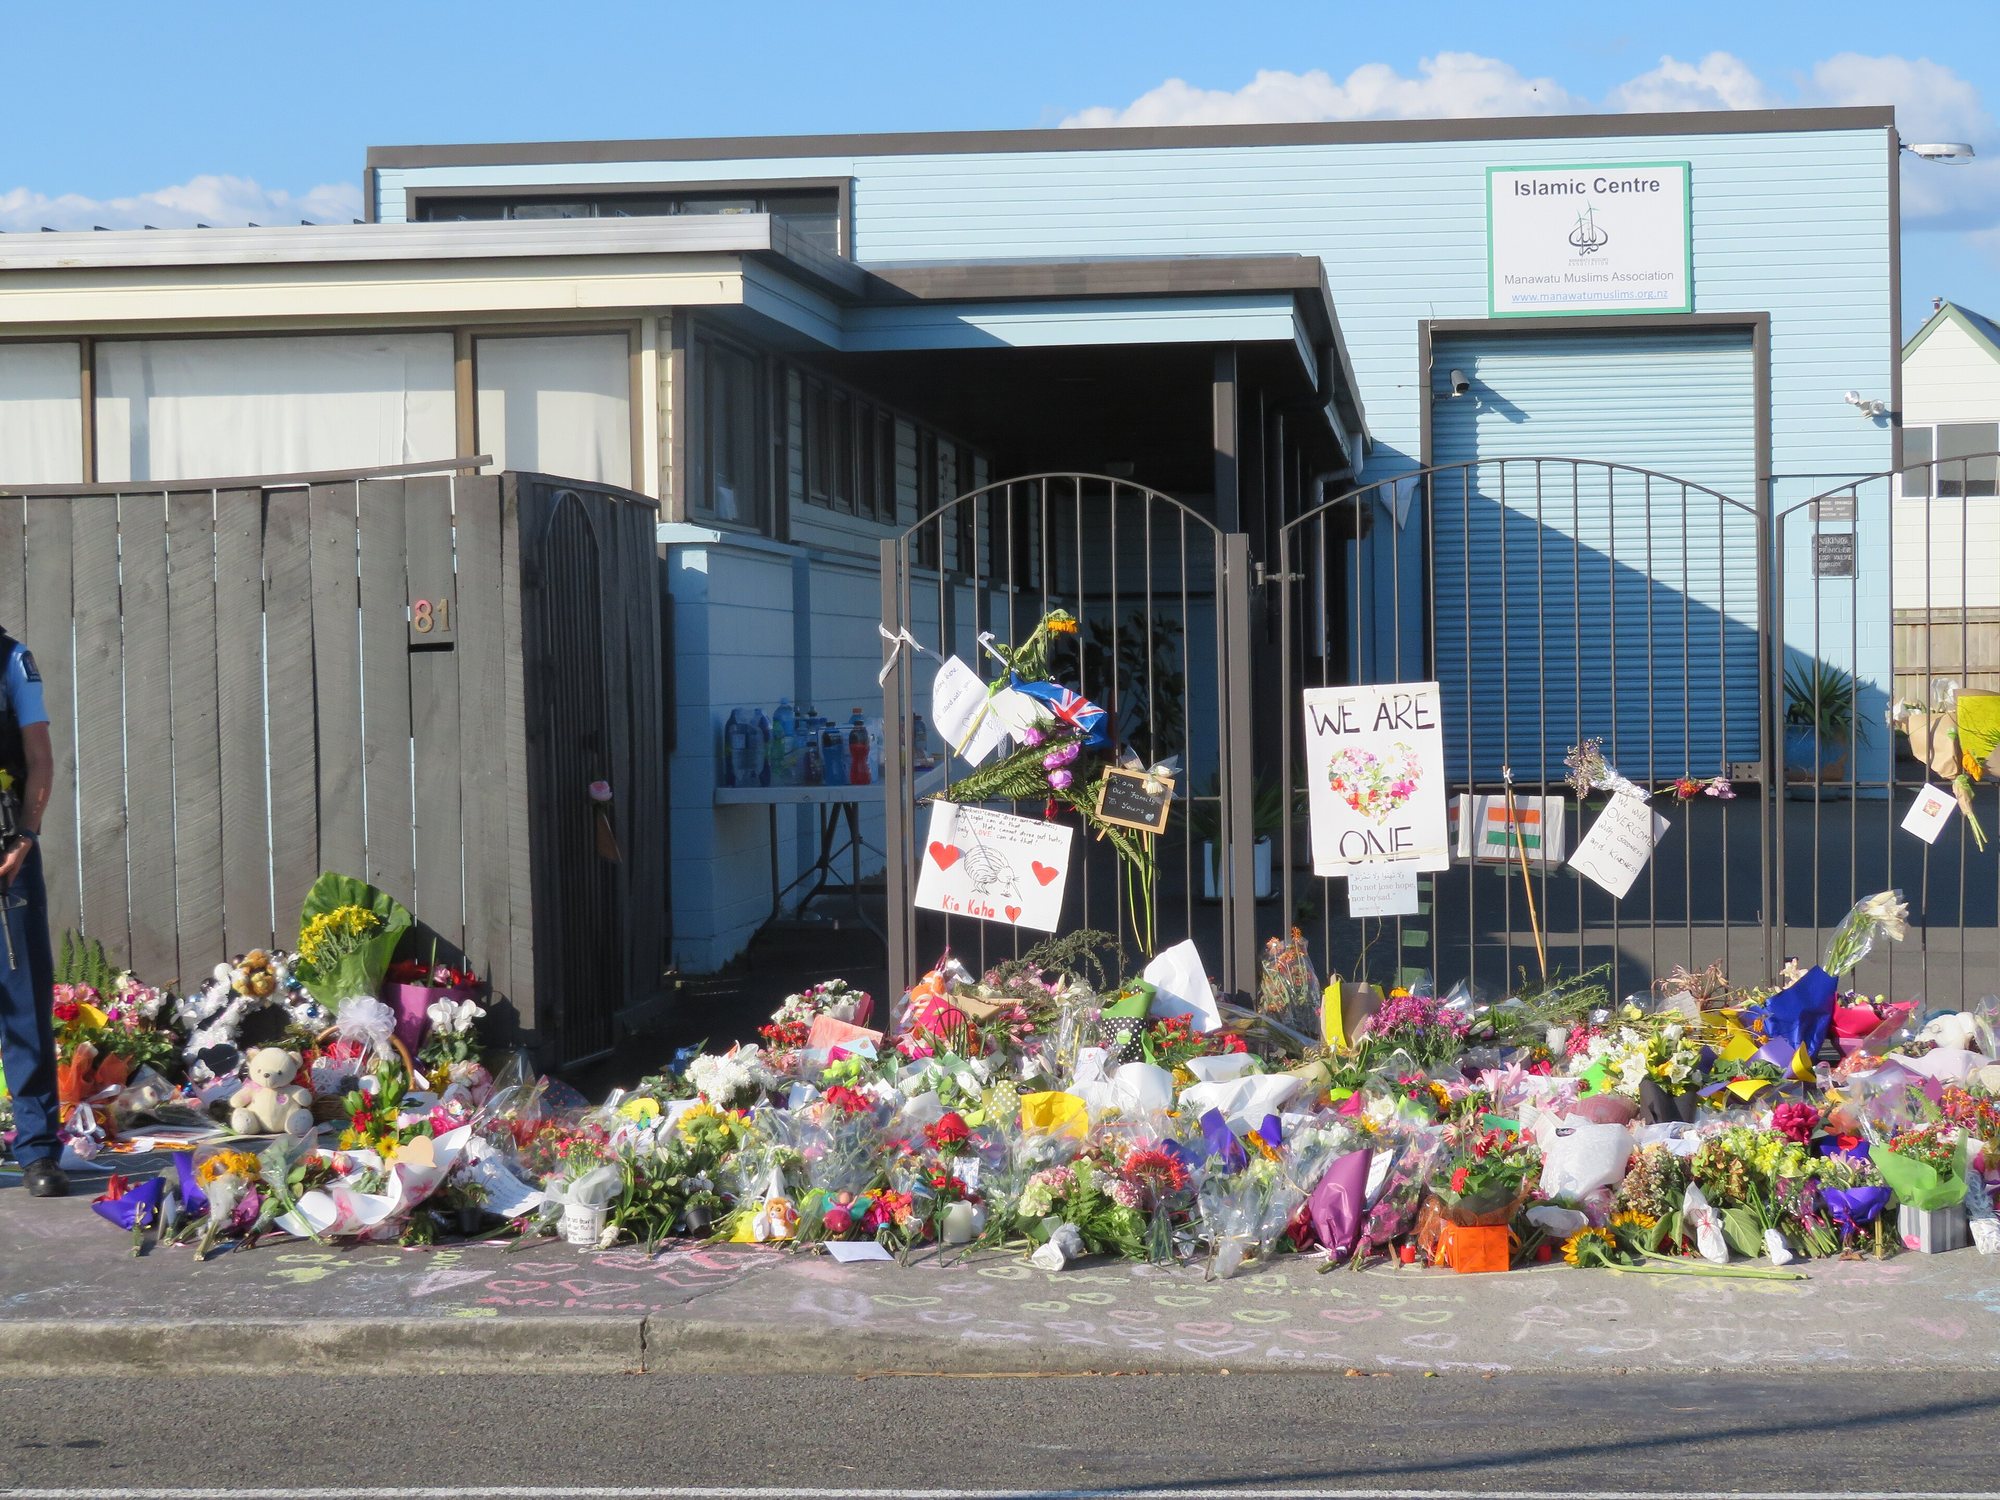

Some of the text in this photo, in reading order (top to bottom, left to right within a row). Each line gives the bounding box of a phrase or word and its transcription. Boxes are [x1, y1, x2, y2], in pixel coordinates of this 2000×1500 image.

[1514, 177, 1661, 196] Islamic Centre
[1504, 270, 1675, 285] Manawatu Muslims Association
[1511, 289, 1669, 303] www.manawatumuslims.org.nz
[415, 598, 449, 633] 81
[1307, 692, 1436, 736] WE ARE
[1339, 826, 1421, 865] ONE
[942, 894, 995, 918] Kia Kaha
[1376, 1294, 1466, 1308] you
